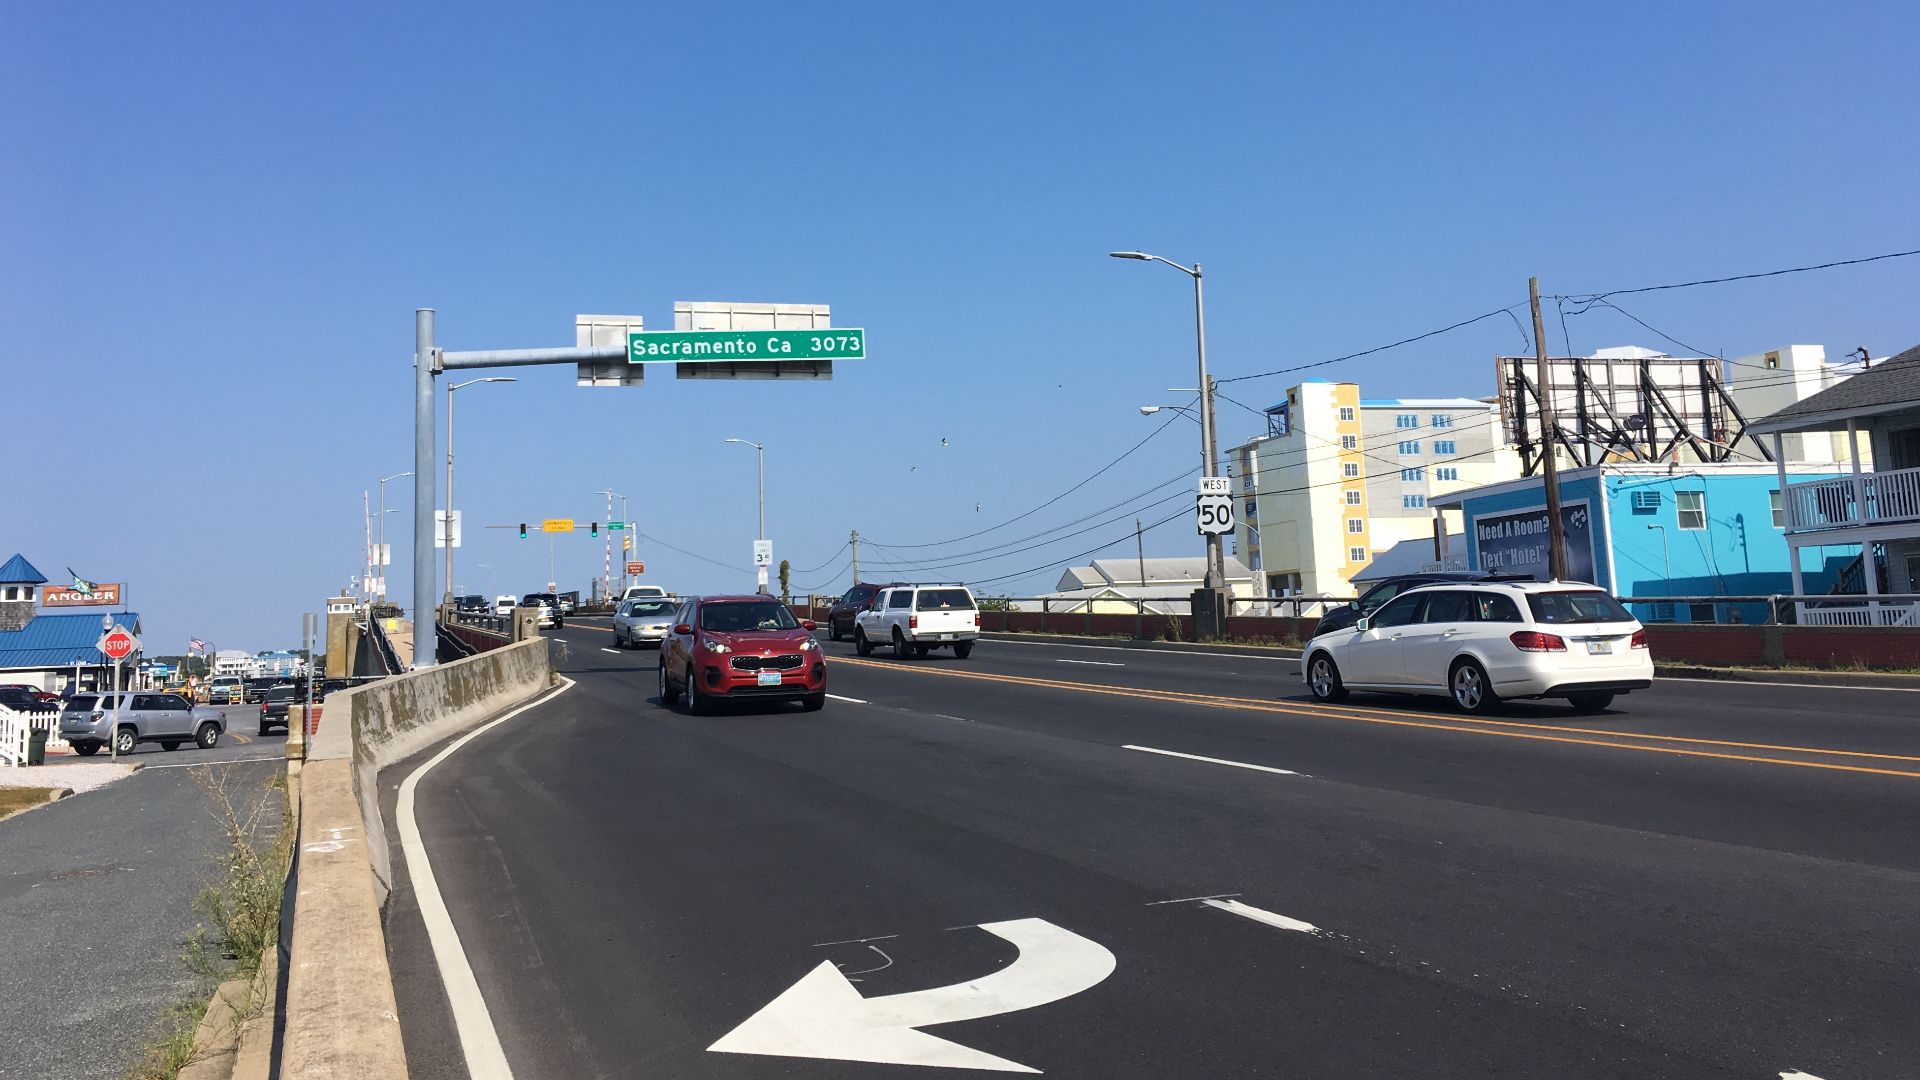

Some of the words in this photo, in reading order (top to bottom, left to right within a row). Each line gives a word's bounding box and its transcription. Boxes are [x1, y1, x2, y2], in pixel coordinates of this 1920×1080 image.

[633, 338, 757, 355] Sacramento
[767, 337, 792, 353] Ca
[810, 336, 861, 352] 3073
[1202, 480, 1228, 490] WEST
[1202, 504, 1230, 525] 50
[1479, 521, 1504, 541] Need
[1505, 521, 1513, 538] A
[1514, 515, 1550, 537] Room?
[1481, 548, 1505, 569] Text
[46, 591, 115, 602] ANGLER
[106, 640, 130, 651] STOP
